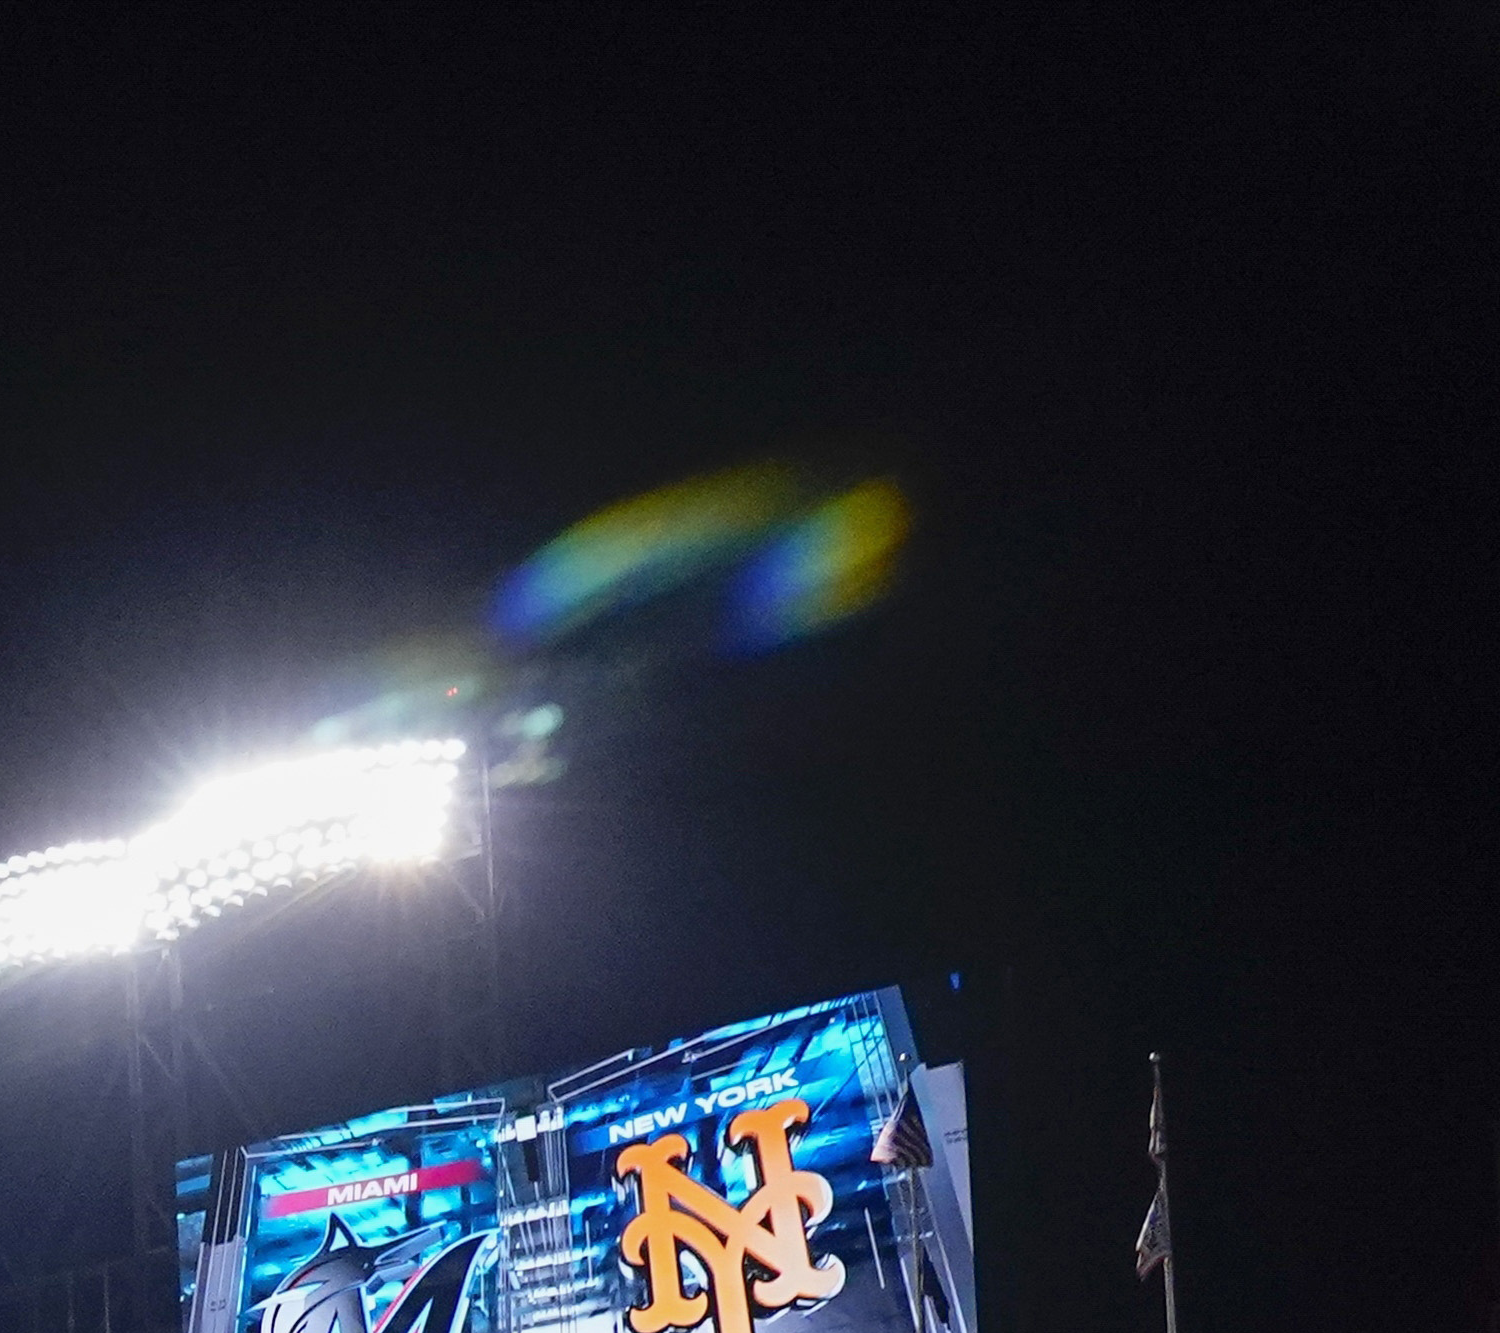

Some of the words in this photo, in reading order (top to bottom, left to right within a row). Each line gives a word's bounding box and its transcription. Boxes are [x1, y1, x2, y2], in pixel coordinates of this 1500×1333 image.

[609, 1103, 687, 1143] NEW
[695, 1067, 799, 1116] YORK
[327, 1173, 418, 1206] MIAMI
